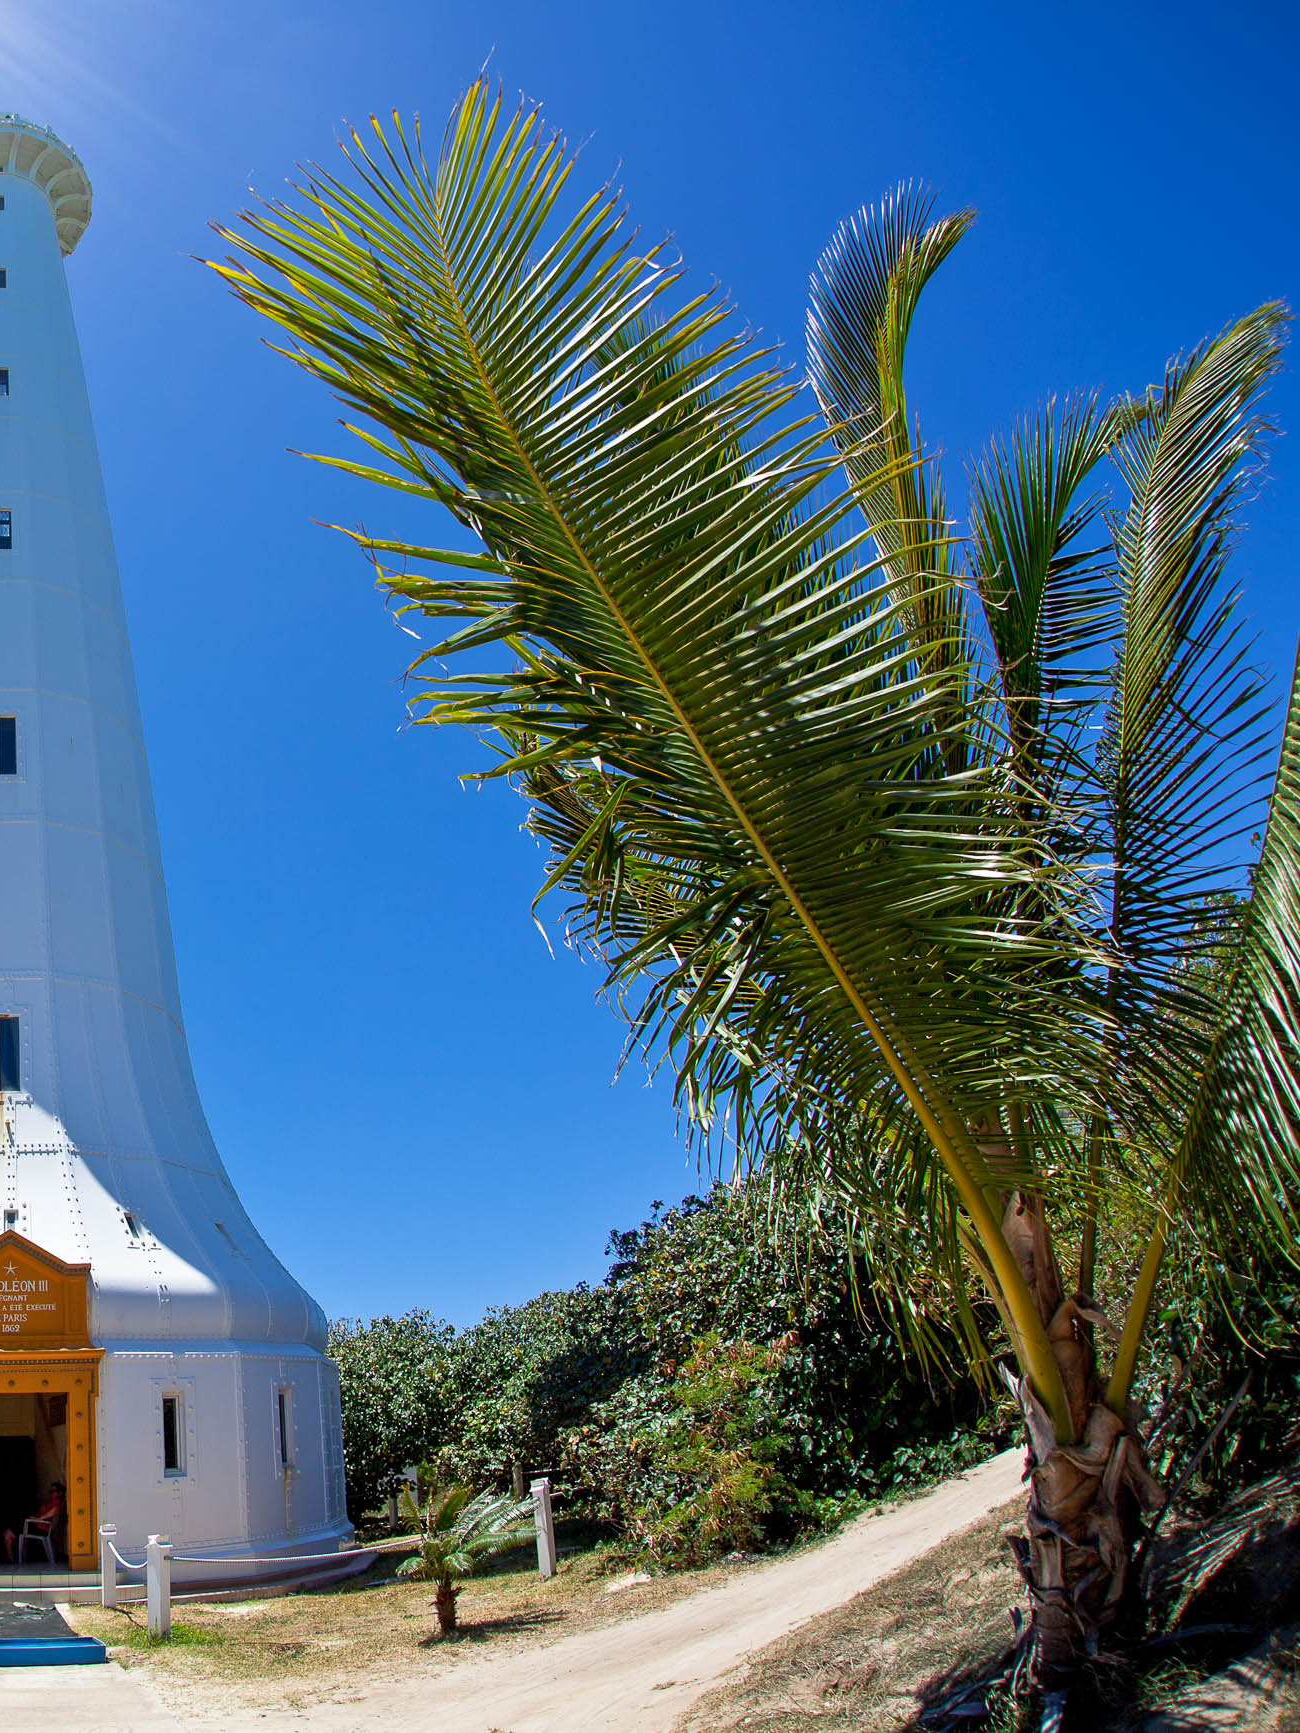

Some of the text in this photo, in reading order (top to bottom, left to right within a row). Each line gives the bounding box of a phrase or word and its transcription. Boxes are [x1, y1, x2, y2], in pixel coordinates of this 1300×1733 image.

[38, 1280, 48, 1292] III
[3, 1313, 28, 1322] PARIS
[2, 1324, 20, 1333] 1862
